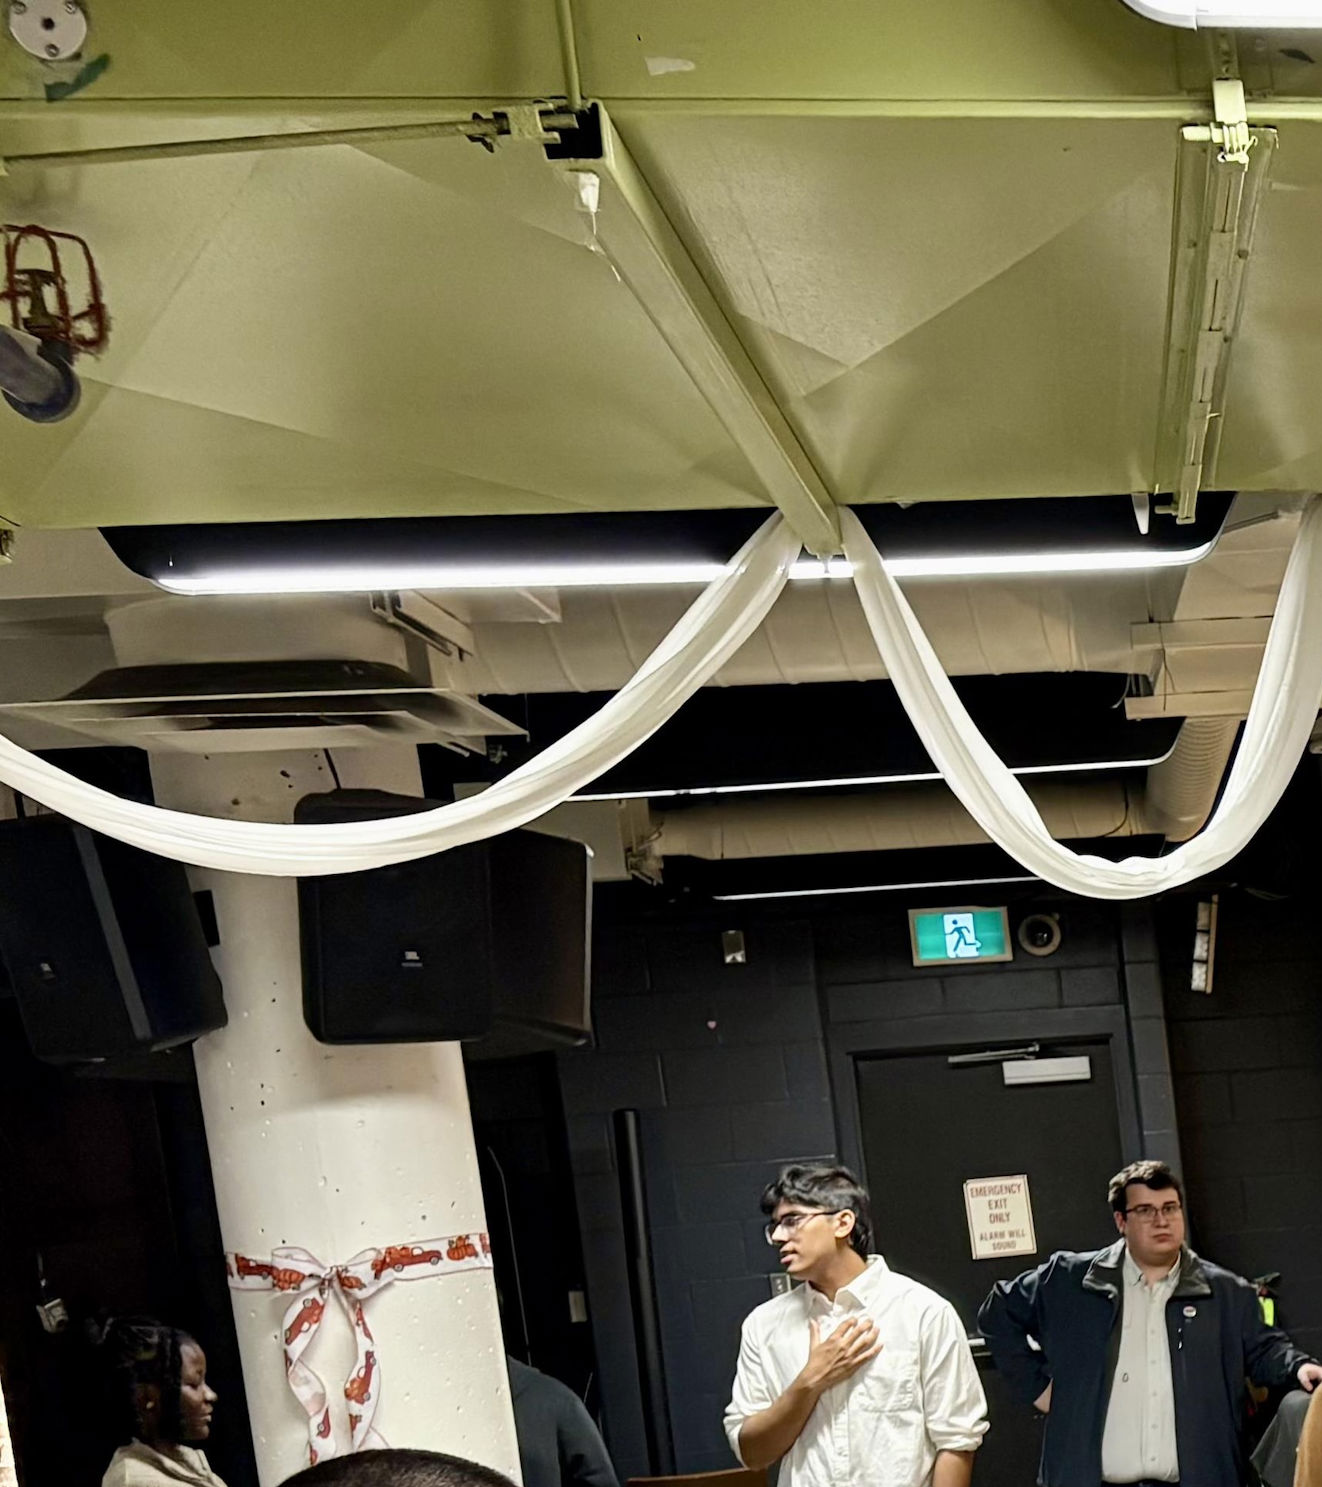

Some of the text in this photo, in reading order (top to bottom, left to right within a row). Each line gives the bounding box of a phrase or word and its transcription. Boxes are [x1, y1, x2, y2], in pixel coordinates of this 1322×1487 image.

[970, 1183, 1022, 1198] EMERGENCY
[988, 1199, 1008, 1210] EXIT
[989, 1212, 1011, 1224] ONLY
[980, 1228, 1026, 1241] ALARM WILL
[993, 1241, 1017, 1251] SOUND
